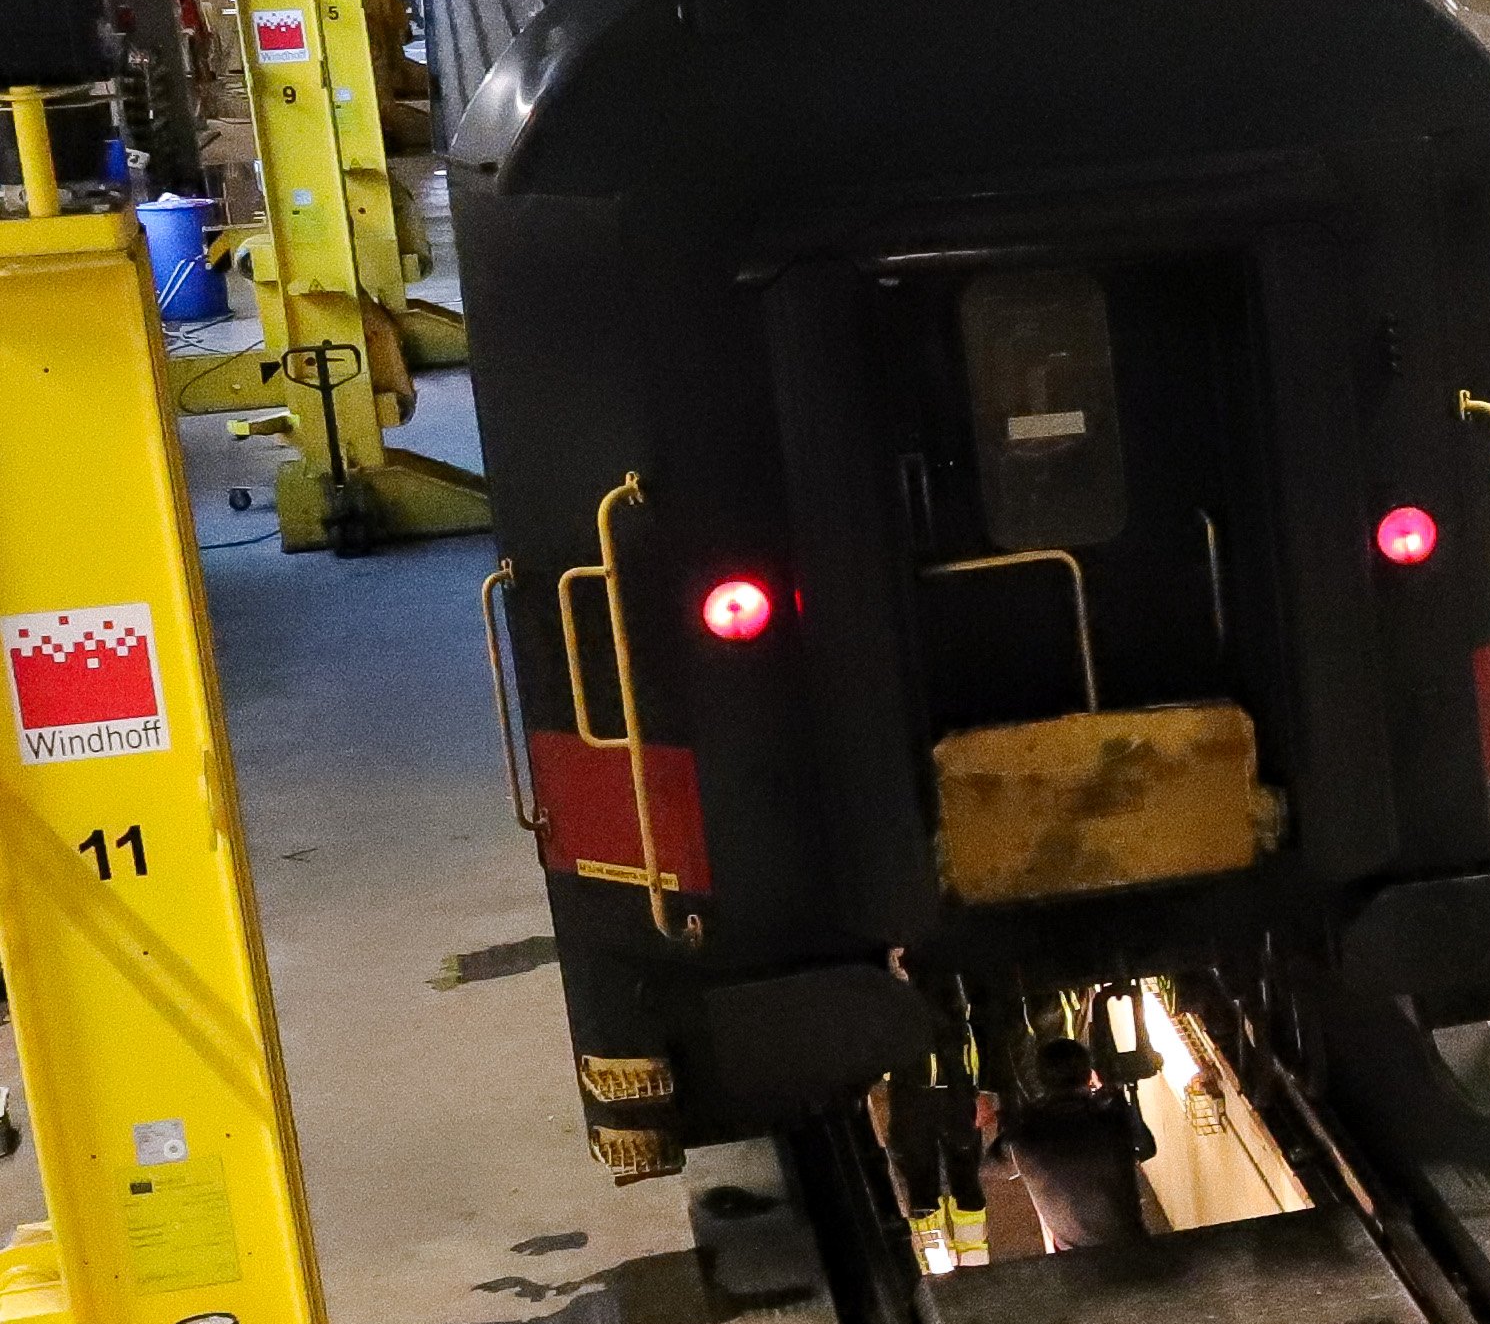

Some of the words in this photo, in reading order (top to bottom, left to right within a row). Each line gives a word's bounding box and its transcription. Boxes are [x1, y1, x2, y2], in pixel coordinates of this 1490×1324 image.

[328, 6, 339, 20] 5
[282, 86, 297, 104] 9
[25, 718, 161, 760] Windhoff
[78, 824, 148, 882] 11
